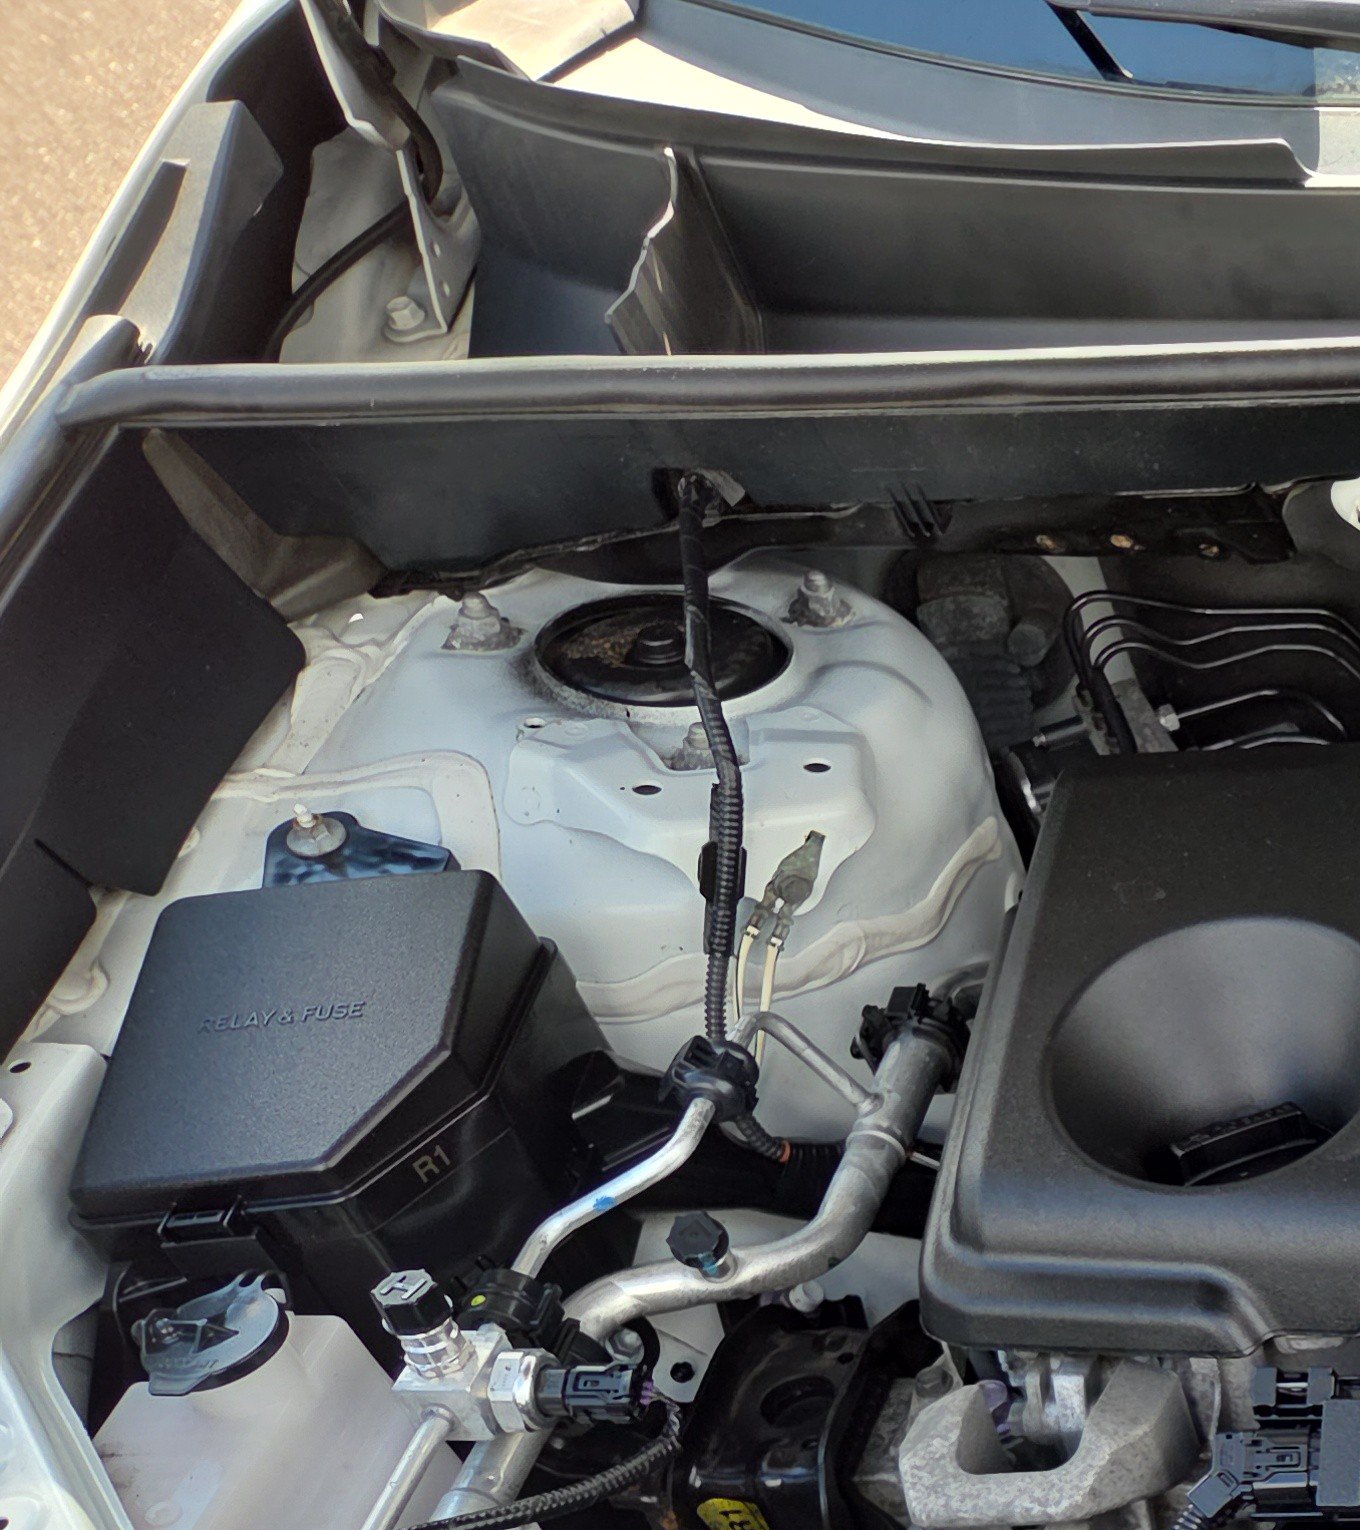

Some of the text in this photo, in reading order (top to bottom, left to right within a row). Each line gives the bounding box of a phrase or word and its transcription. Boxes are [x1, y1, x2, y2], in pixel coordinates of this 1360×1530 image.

[198, 1008, 279, 1034] RELAY
[301, 1001, 367, 1023] FUSE
[412, 1145, 450, 1184] R1
